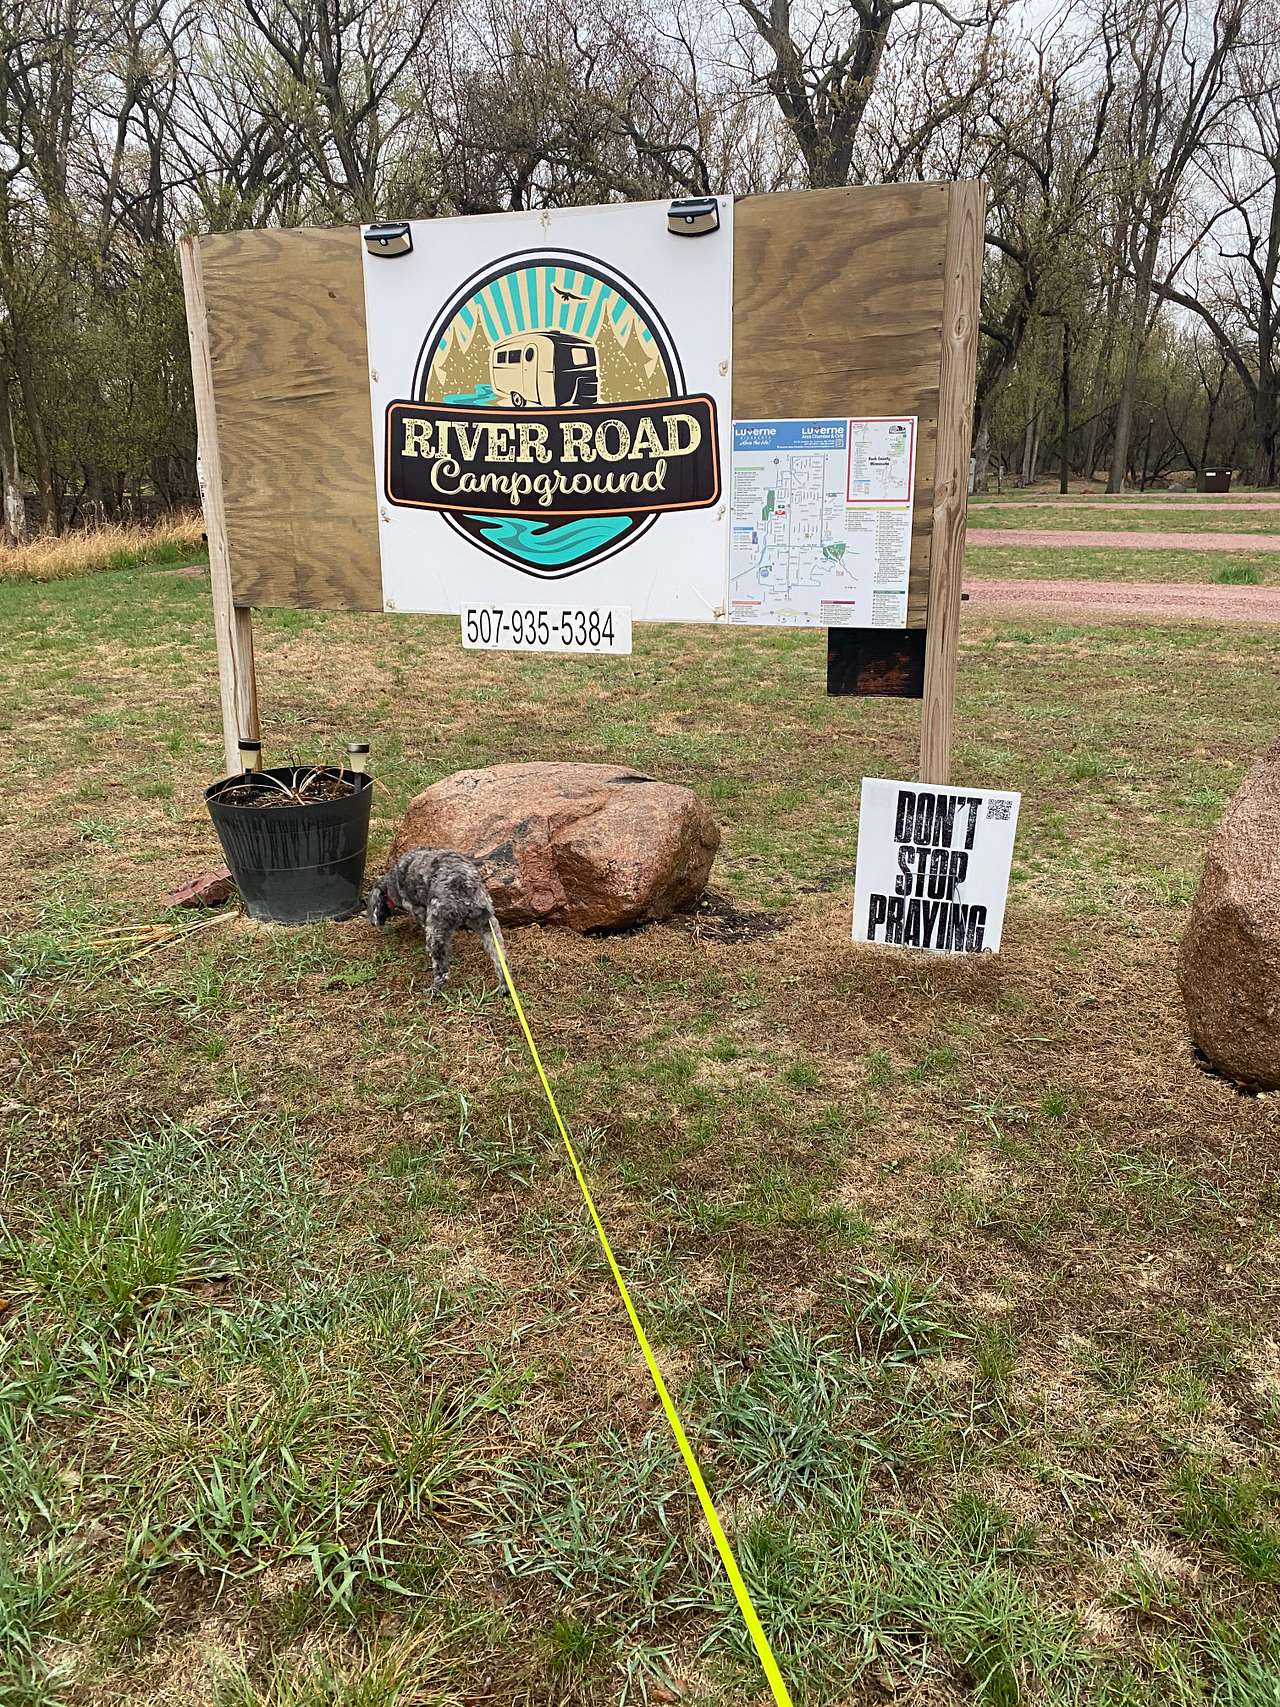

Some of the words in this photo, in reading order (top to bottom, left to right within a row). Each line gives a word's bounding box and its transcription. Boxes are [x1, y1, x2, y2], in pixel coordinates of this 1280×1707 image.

[401, 417, 552, 464] RIVER
[559, 413, 702, 464] ROAD
[430, 458, 668, 508] Campground
[467, 609, 615, 646] 507-935-5384
[894, 790, 983, 850] DON'T
[895, 845, 969, 900] STOP
[867, 893, 988, 953] PRAYING
